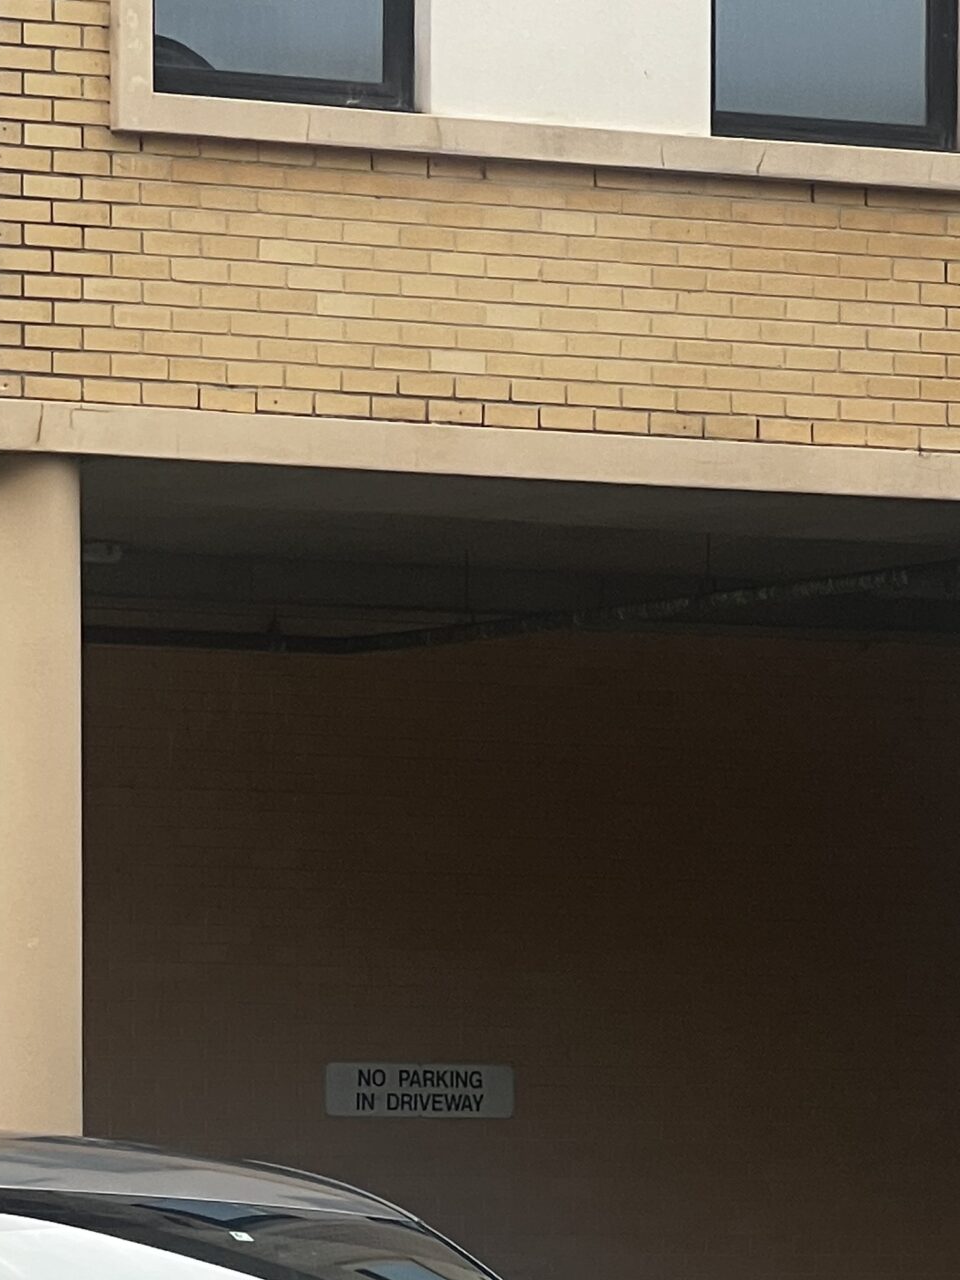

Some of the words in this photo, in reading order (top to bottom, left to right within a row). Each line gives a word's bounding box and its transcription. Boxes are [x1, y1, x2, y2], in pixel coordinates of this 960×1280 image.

[357, 1069, 386, 1087] NO
[398, 1070, 483, 1089] PARKING
[356, 1093, 375, 1111] IN
[386, 1093, 484, 1112] DRIVEWAY
